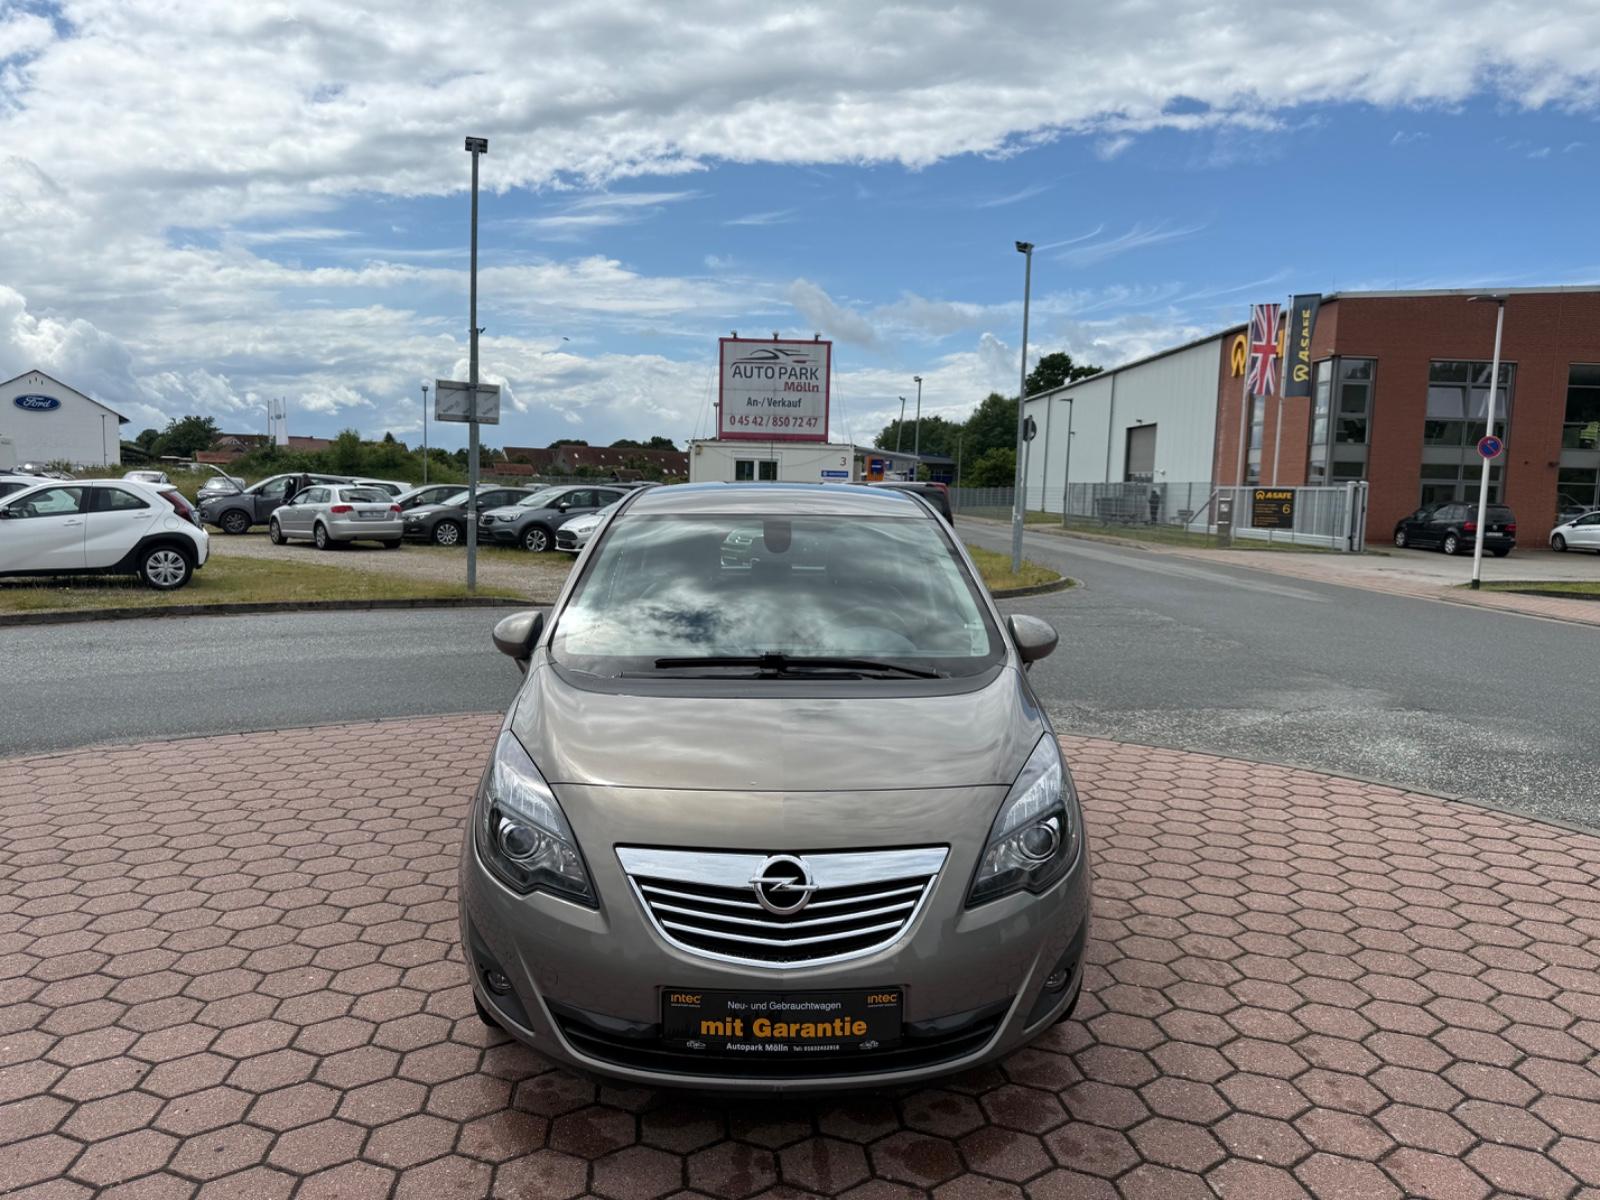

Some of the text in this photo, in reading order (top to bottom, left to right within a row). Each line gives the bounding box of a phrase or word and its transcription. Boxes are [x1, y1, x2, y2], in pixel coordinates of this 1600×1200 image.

[784, 381, 819, 393] Mölln
[23, 396, 52, 409] Ford
[767, 397, 802, 408] Verkauf
[840, 456, 847, 466] 3
[1282, 503, 1291, 514] 6
[727, 1000, 841, 1012] Neu- und Gebrauchtwagen
[700, 1016, 867, 1039] mit Garantie
[726, 1043, 764, 1052] Autopark
[764, 1043, 789, 1052] Mölln
